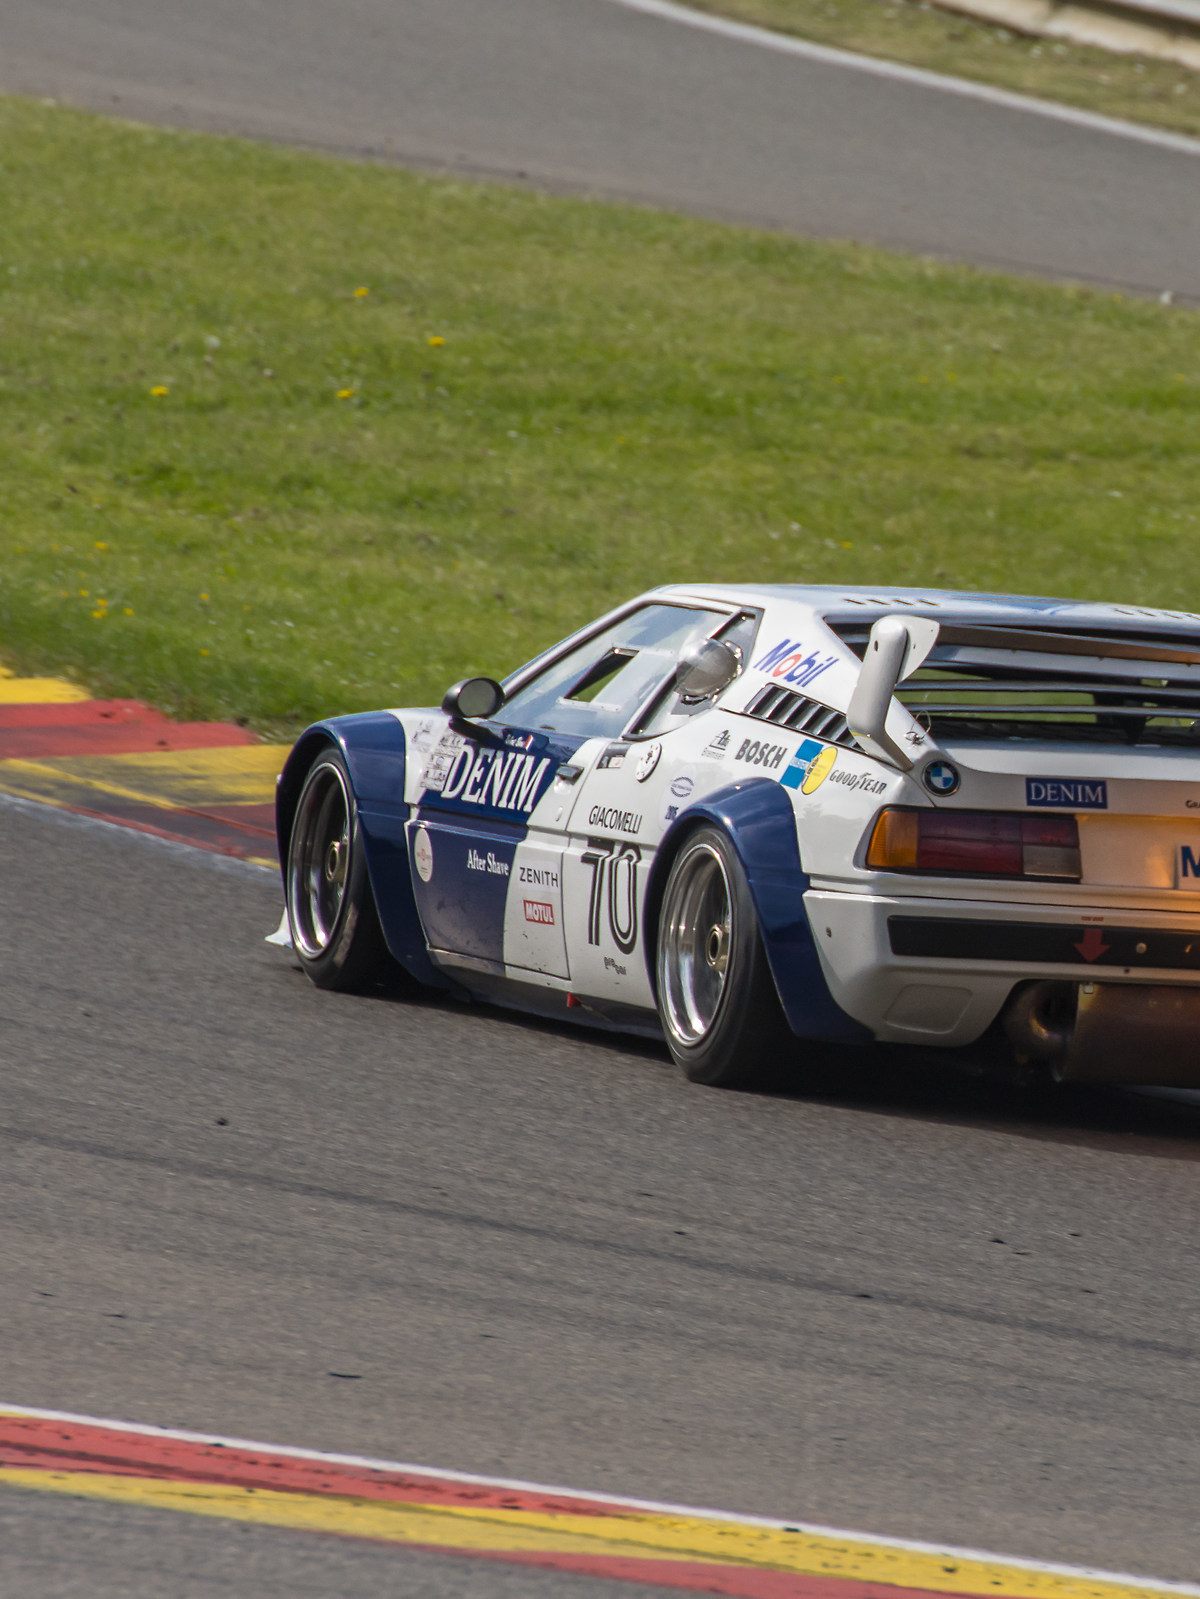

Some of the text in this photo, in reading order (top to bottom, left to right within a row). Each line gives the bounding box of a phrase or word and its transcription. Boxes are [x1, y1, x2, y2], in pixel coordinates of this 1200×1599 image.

[753, 638, 839, 688] Mobil
[735, 738, 787, 769] BOSCH
[440, 744, 551, 813] DENIM
[829, 769, 887, 795] GOODYEAR
[1030, 782, 1104, 803] DENIM
[588, 805, 643, 834] GIACOMELLI
[467, 849, 510, 876] After Shave
[519, 867, 559, 888] ZENITH
[580, 836, 642, 955] 70
[525, 902, 553, 923] MOTUL
